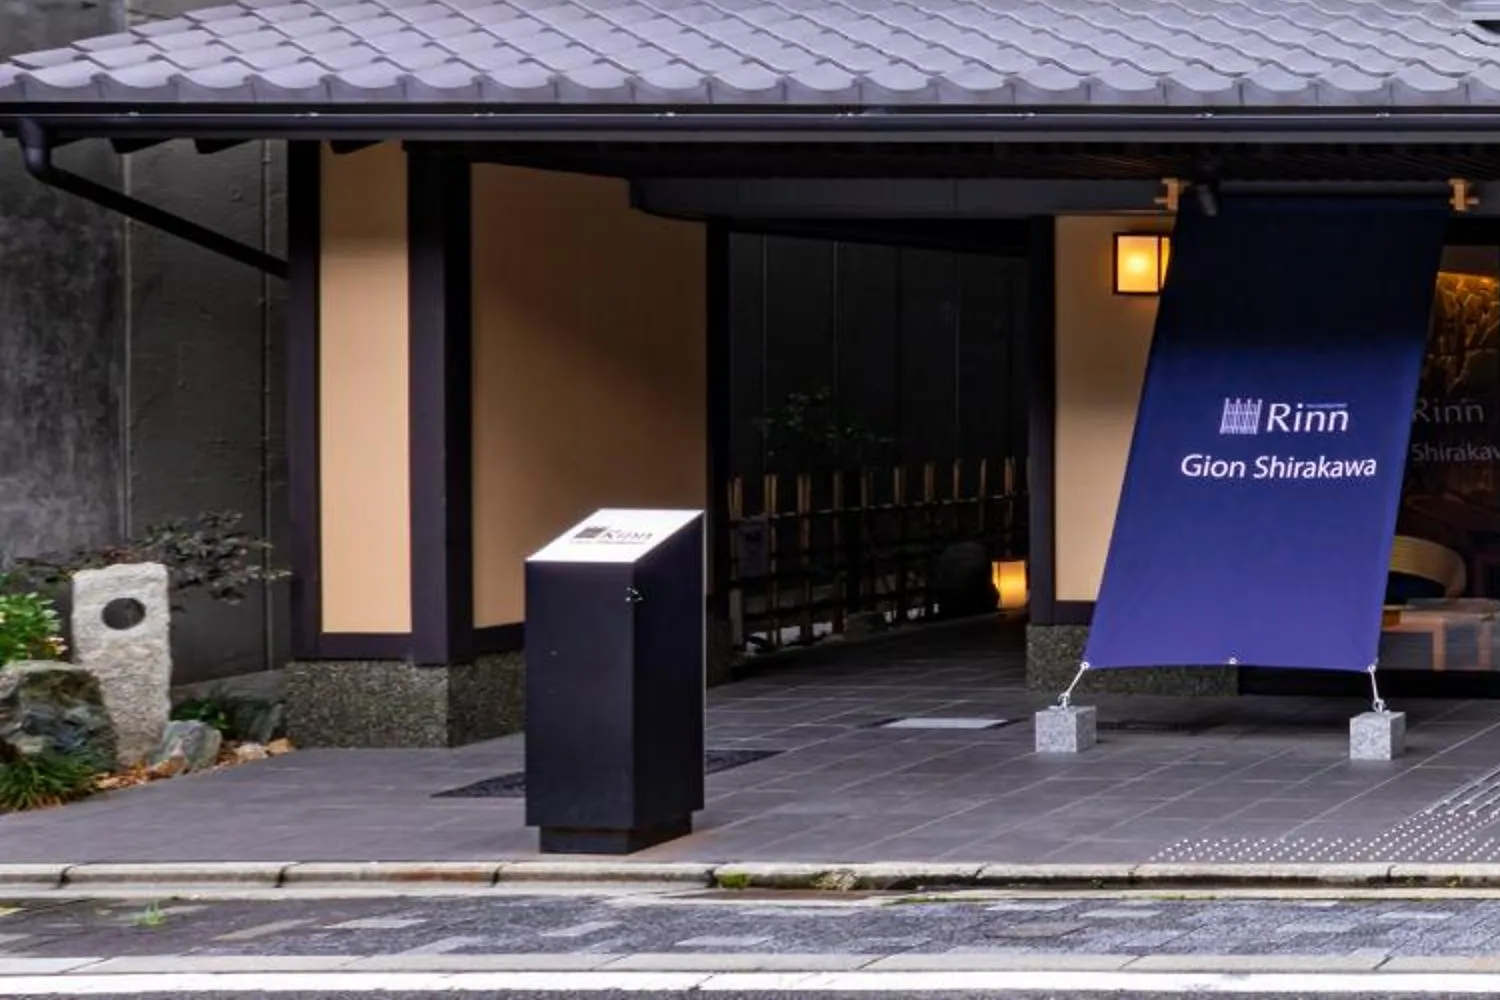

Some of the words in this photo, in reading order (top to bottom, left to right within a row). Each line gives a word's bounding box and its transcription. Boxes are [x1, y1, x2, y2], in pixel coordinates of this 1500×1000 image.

[1266, 402, 1349, 433] Rinn
[1180, 453, 1246, 478] Gion
[1252, 455, 1377, 479] Shirakawa
